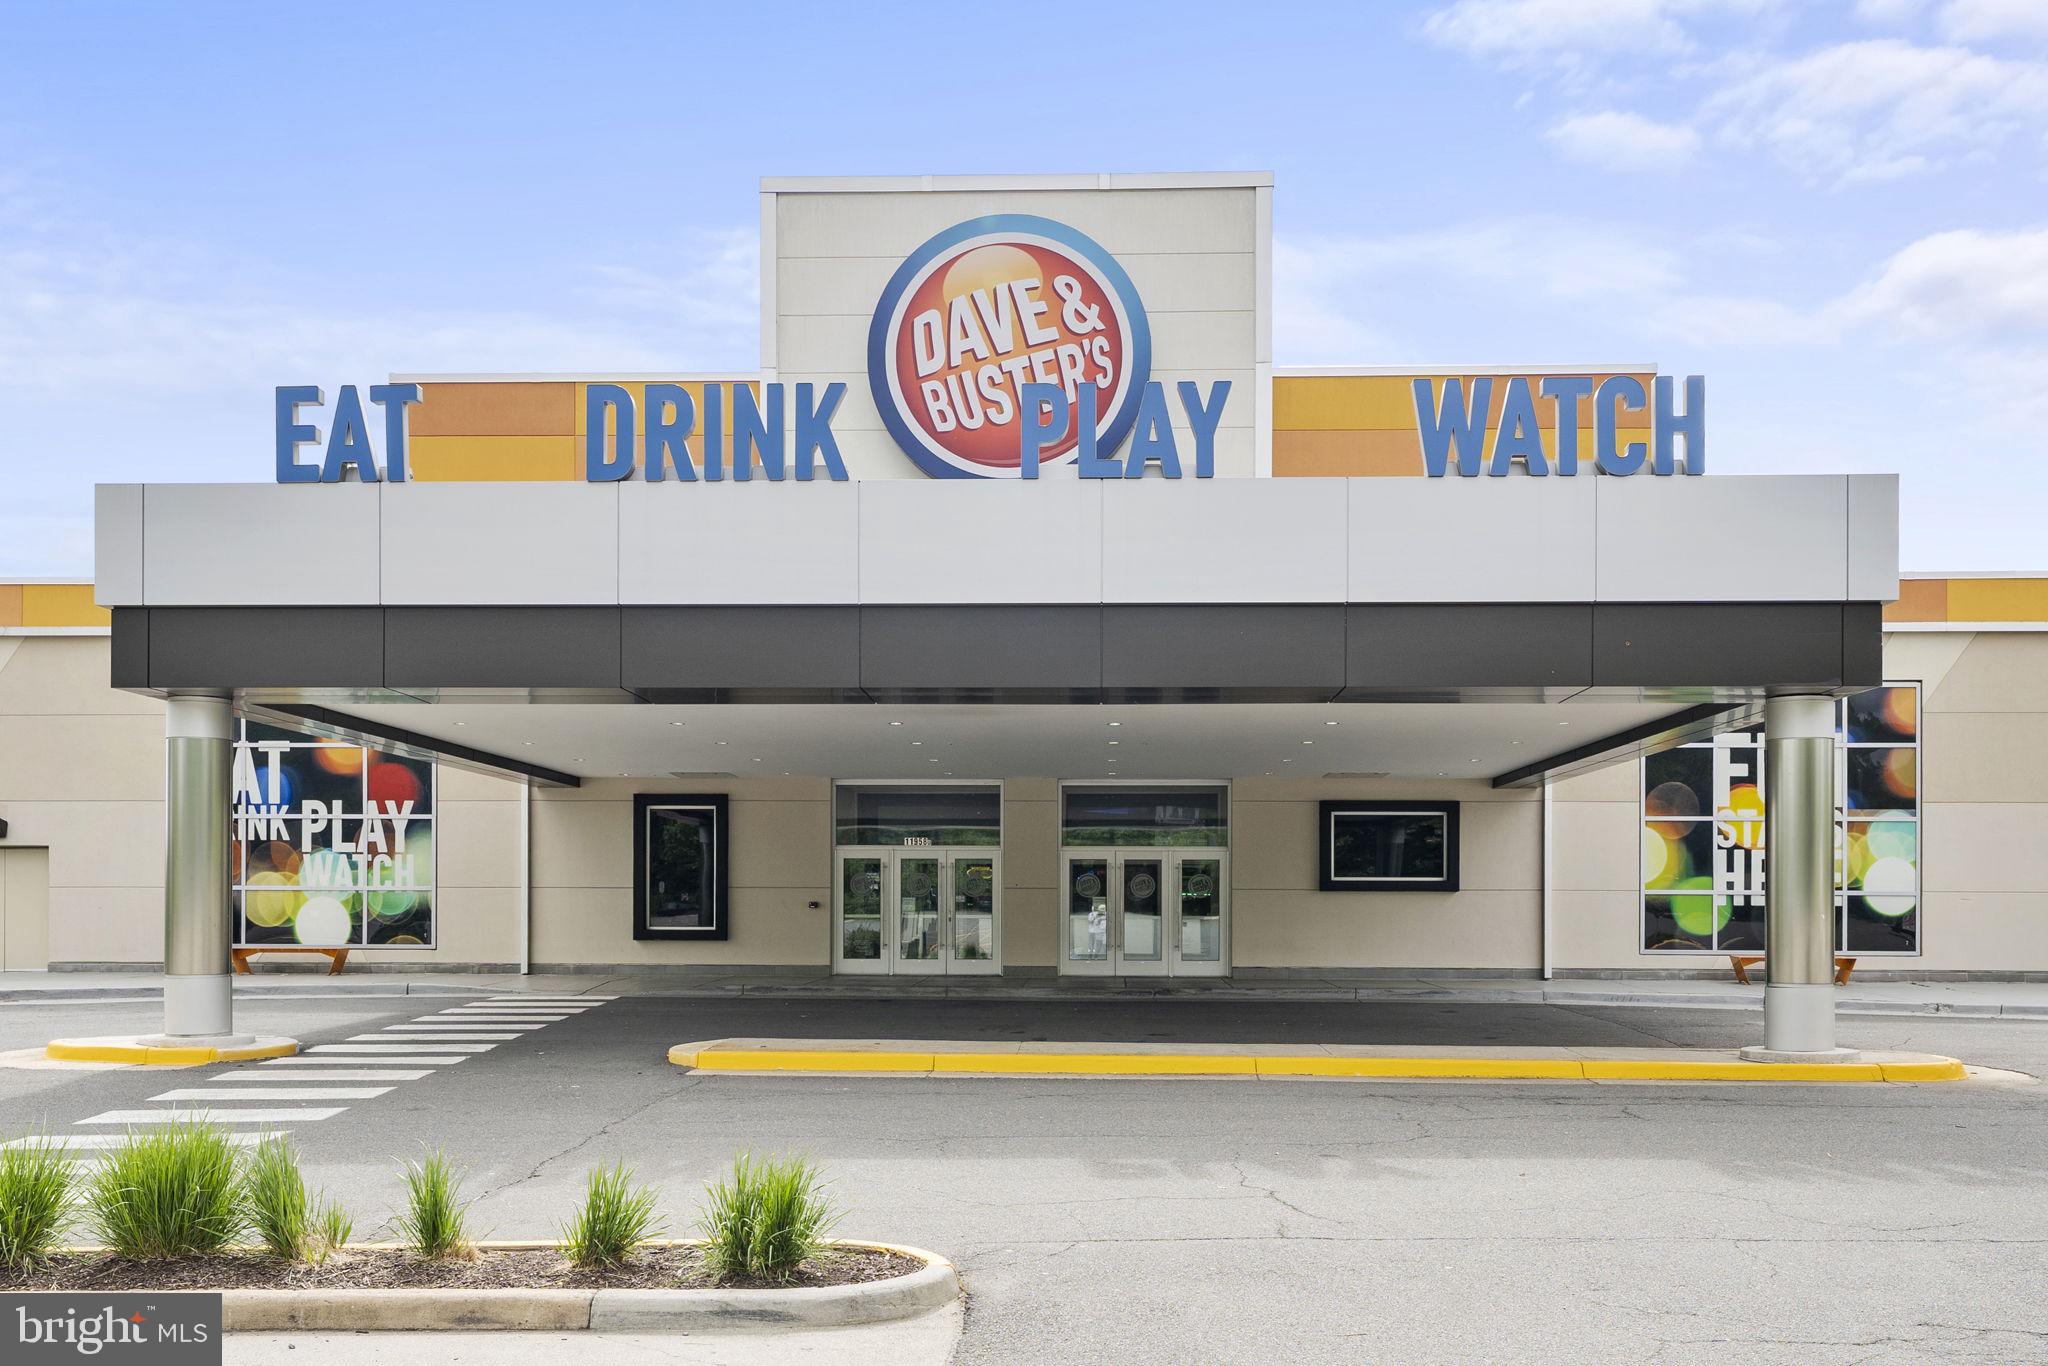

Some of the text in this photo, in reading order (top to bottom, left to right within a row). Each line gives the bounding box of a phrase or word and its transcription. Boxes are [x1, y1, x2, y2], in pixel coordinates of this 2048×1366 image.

[913, 275, 1106, 378] DAVE &
[921, 335, 1114, 433] BUSTER'S
[275, 375, 1705, 483] EAT DRINK PLAY WATCH
[233, 741, 290, 804] AT
[233, 805, 290, 841] INK
[301, 800, 415, 853] PLAY
[302, 854, 415, 890] WATCH
